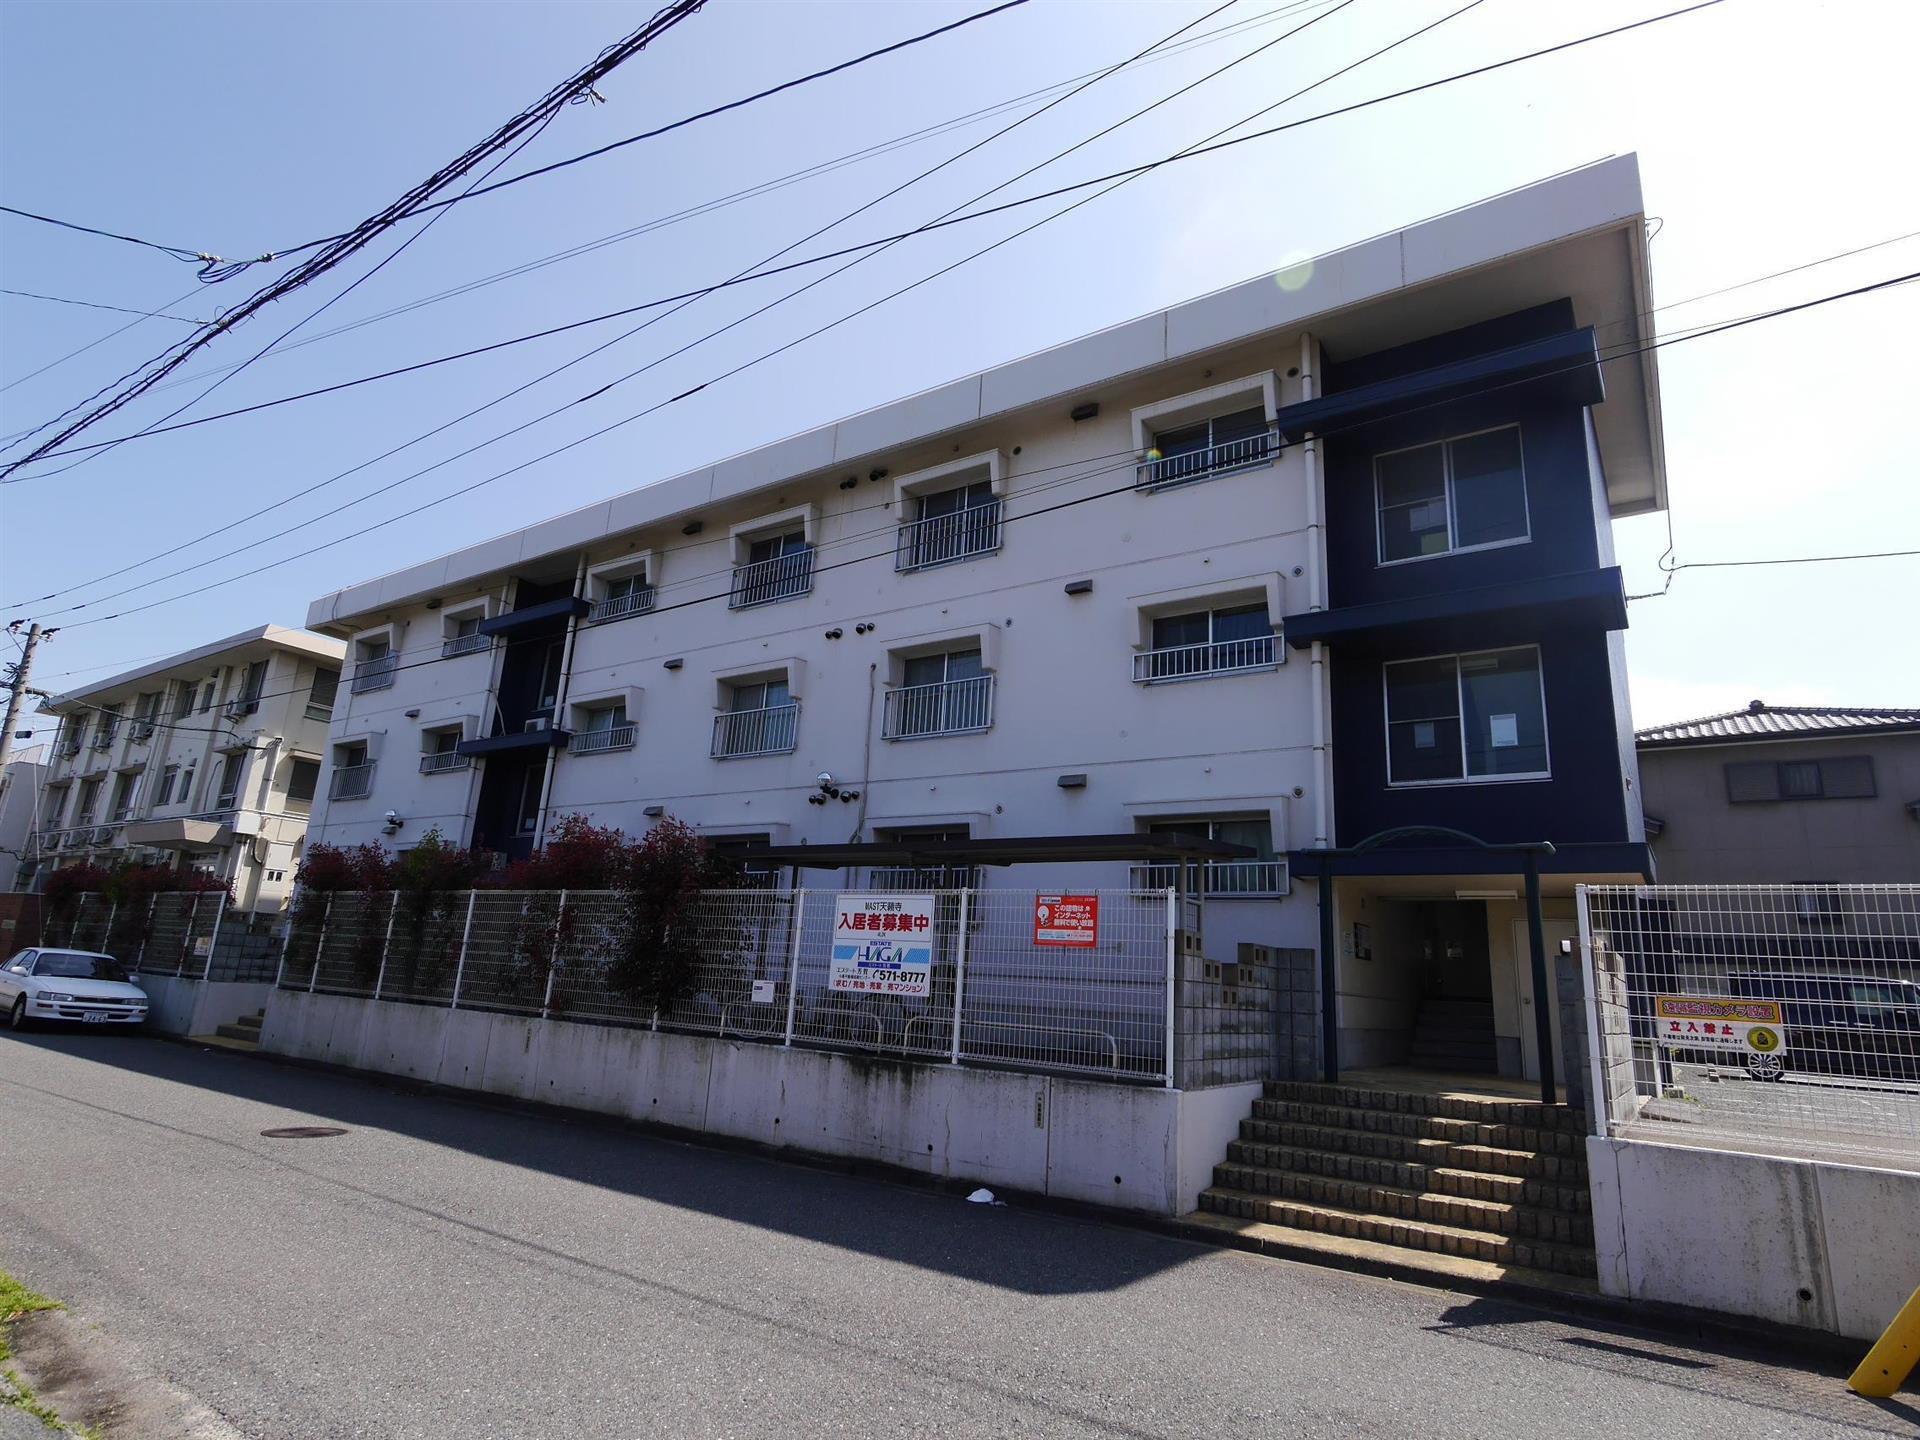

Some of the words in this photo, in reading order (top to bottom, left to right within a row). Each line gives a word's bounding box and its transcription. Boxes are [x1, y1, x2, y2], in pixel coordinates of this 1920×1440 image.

[838, 913, 929, 932] 入居者募集中
[859, 946, 903, 962] HAGA
[879, 969, 926, 983] 571-8777
[1669, 1021, 1734, 1036] 立入禁止
